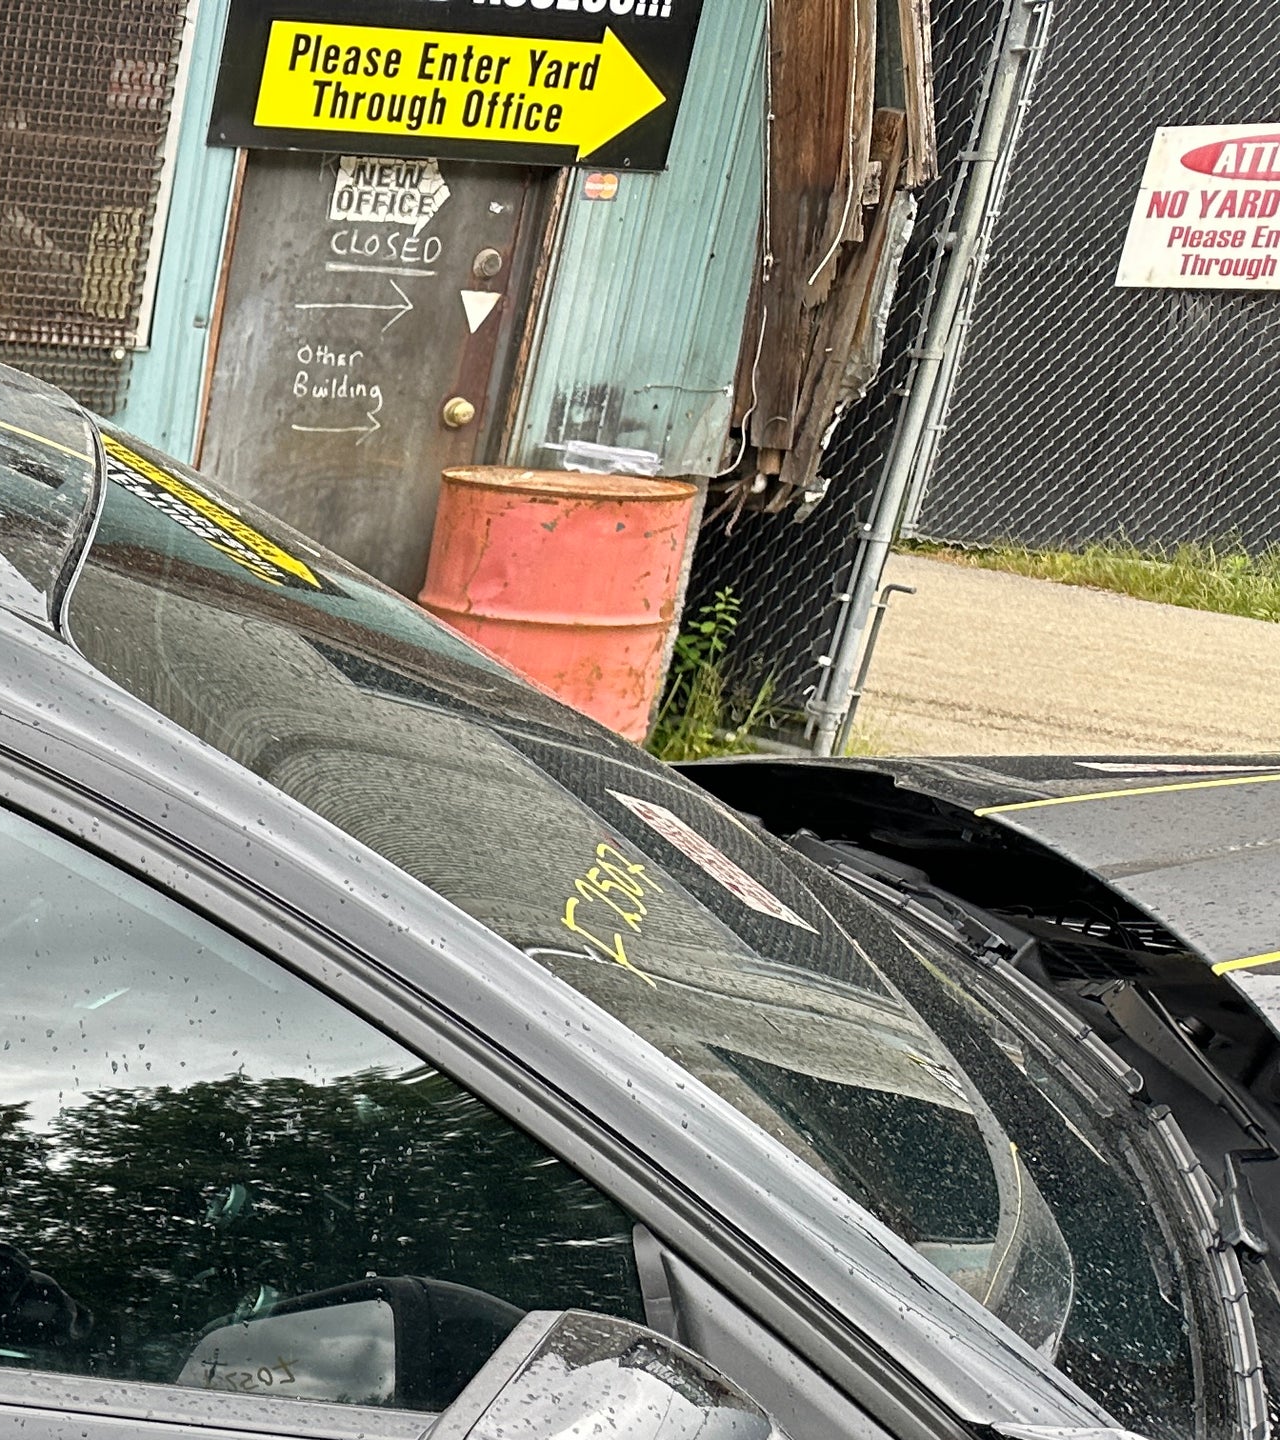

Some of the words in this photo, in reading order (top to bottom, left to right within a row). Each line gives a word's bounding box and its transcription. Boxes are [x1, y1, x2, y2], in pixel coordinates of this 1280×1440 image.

[289, 33, 403, 79] Please
[417, 42, 511, 86] Enter
[529, 49, 602, 91] Yard
[312, 80, 447, 131] Through
[462, 89, 564, 135] Office
[1211, 142, 1280, 174] ATT
[353, 162, 424, 188] NEW
[336, 187, 435, 217] OFFICE
[1146, 190, 1189, 219] NO
[1199, 189, 1280, 219] YARD
[331, 229, 442, 263] CLOSED
[1167, 226, 1246, 248] Please
[1180, 254, 1278, 281] Through
[293, 370, 383, 415] Building
